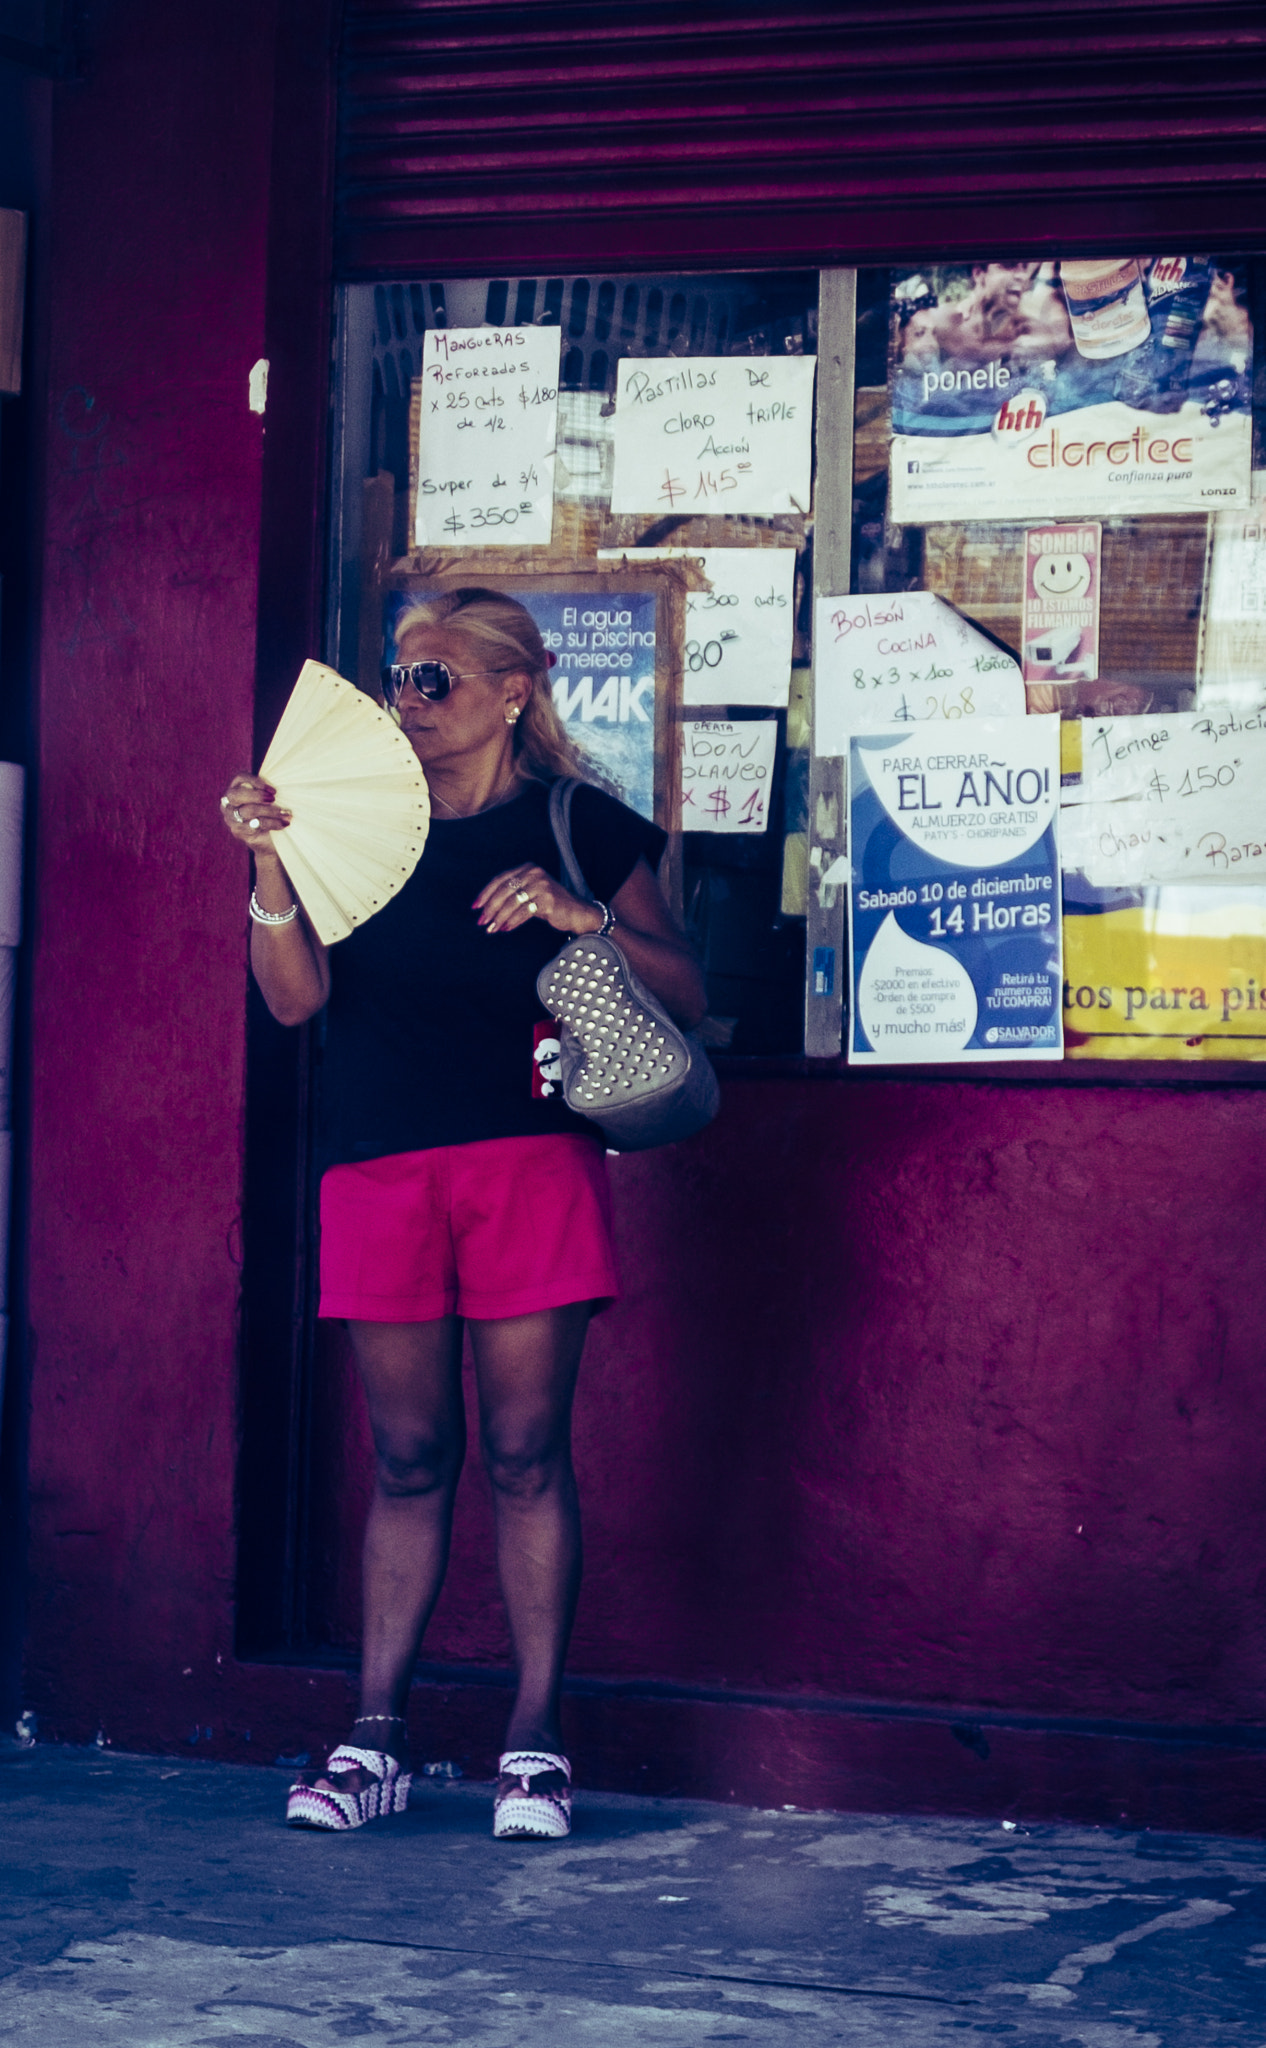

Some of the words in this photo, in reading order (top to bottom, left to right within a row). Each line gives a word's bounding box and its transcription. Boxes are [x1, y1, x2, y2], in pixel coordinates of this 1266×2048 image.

[923, 361, 1011, 401] ponele
[446, 392, 470, 408] 25
[457, 418, 473, 429] de
[998, 400, 1043, 432] hth
[422, 478, 473, 496] Super
[492, 473, 507, 487] de
[519, 464, 539, 491] 3/4
[1108, 470, 1164, 484] Confianza
[1166, 471, 1193, 482] pura
[1028, 529, 1095, 555] SONRÍA
[702, 591, 739, 609] 300
[1028, 599, 1041, 613] LO
[1043, 598, 1093, 612] ESTAMOS
[563, 607, 577, 626] El
[582, 611, 632, 630] agua
[540, 628, 563, 648] de
[567, 632, 588, 647] su
[592, 627, 656, 651] piscina
[559, 652, 633, 669] merece
[853, 668, 866, 689] 8
[889, 667, 900, 684] 3
[1191, 712, 1266, 744] Ratici
[883, 758, 921, 772] PARA
[927, 754, 988, 770] CERRAR
[898, 774, 942, 810] EL
[956, 761, 1050, 808] AÑO!
[912, 813, 985, 828] ALMUERZO
[990, 811, 1038, 825] GRATIS!
[967, 827, 1027, 839] CHORIPANES
[859, 887, 917, 909] Sabado
[921, 883, 943, 903] 10
[948, 881, 967, 899] de
[972, 873, 1052, 897] diciembre
[930, 904, 965, 936] 14
[973, 901, 1051, 931] Horas
[908, 981, 919, 989] en
[922, 978, 960, 989] efectivo
[1037, 972, 1050, 984] tu
[907, 991, 918, 1001] de
[921, 993, 956, 1003] compra
[1034, 986, 1052, 995] con
[896, 1004, 907, 1015] de
[910, 1003, 936, 1015] $500
[986, 996, 1000, 1008] TU
[1125, 986, 1209, 1021] para
[872, 1023, 880, 1038] y
[885, 1019, 931, 1034] mucho
[935, 1018, 966, 1033] más!
[998, 1026, 1056, 1039] SALVADOR
